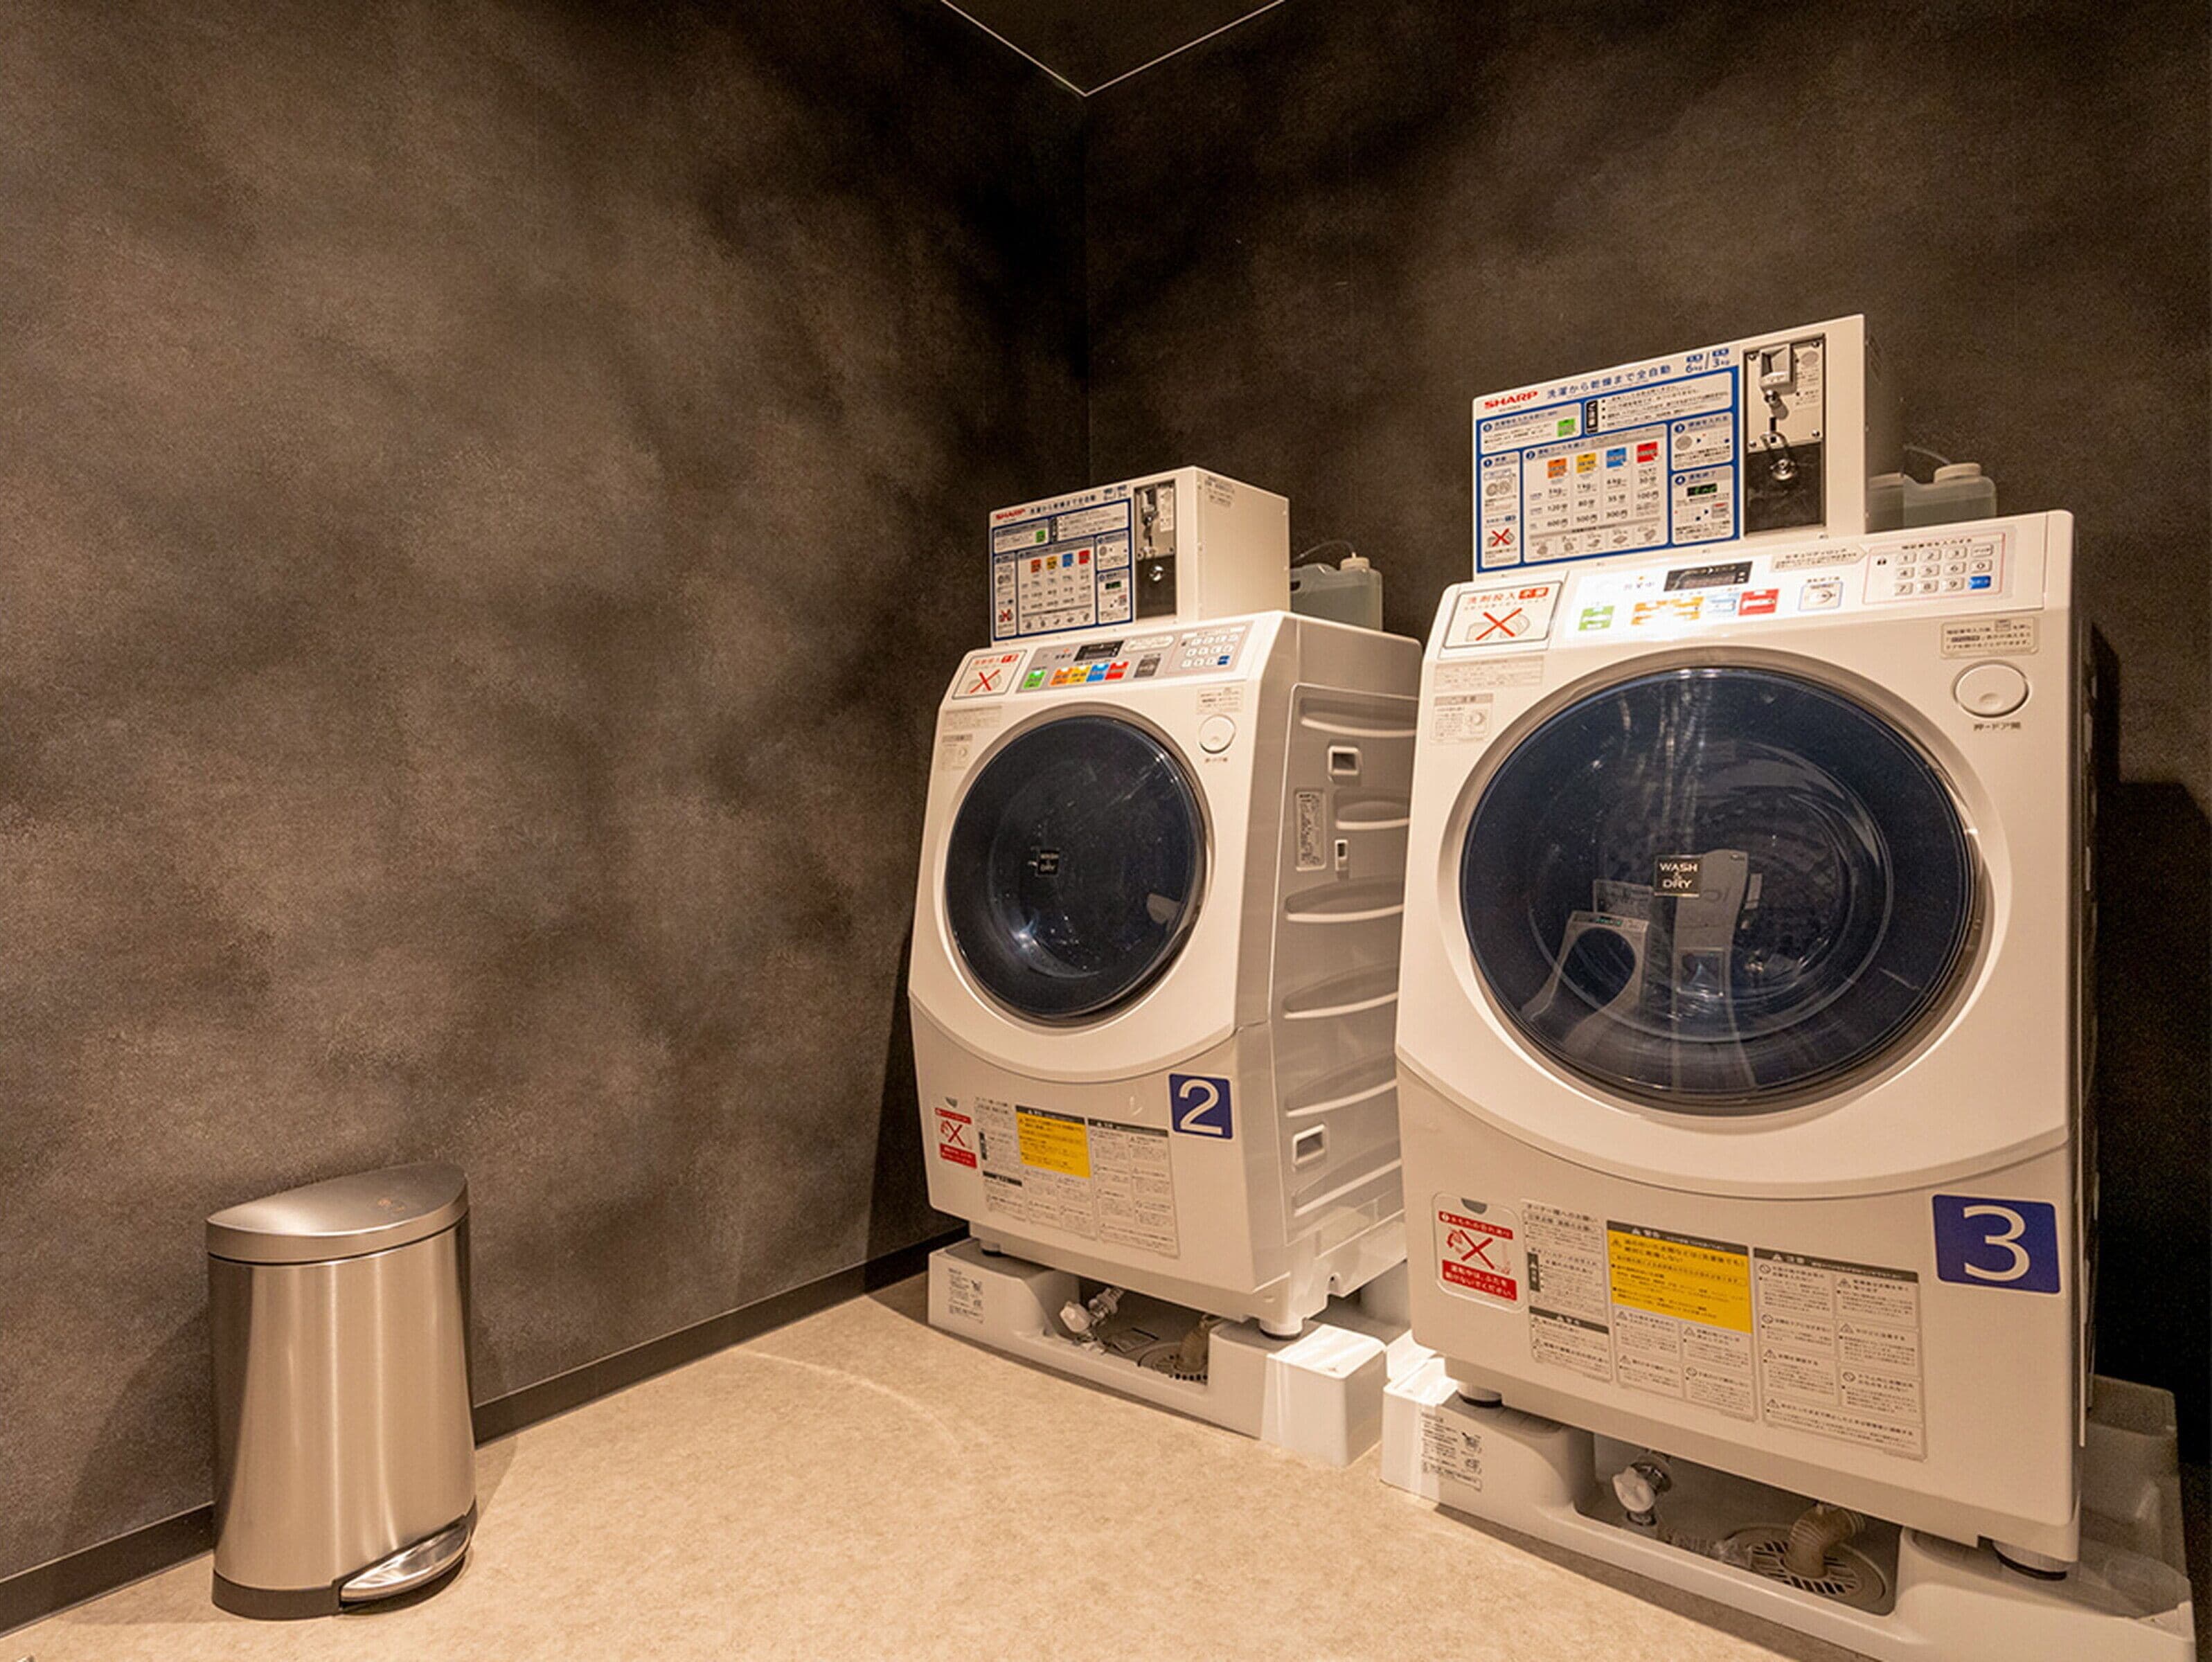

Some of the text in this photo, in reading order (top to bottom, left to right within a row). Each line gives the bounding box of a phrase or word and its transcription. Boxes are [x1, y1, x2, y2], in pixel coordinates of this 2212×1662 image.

[1484, 391, 1538, 409] SHARP
[1659, 863, 1698, 872] WASH
[1663, 879, 1693, 888] DRY
[1179, 1079, 1222, 1135] 2
[1963, 1205, 2031, 1282] 3
